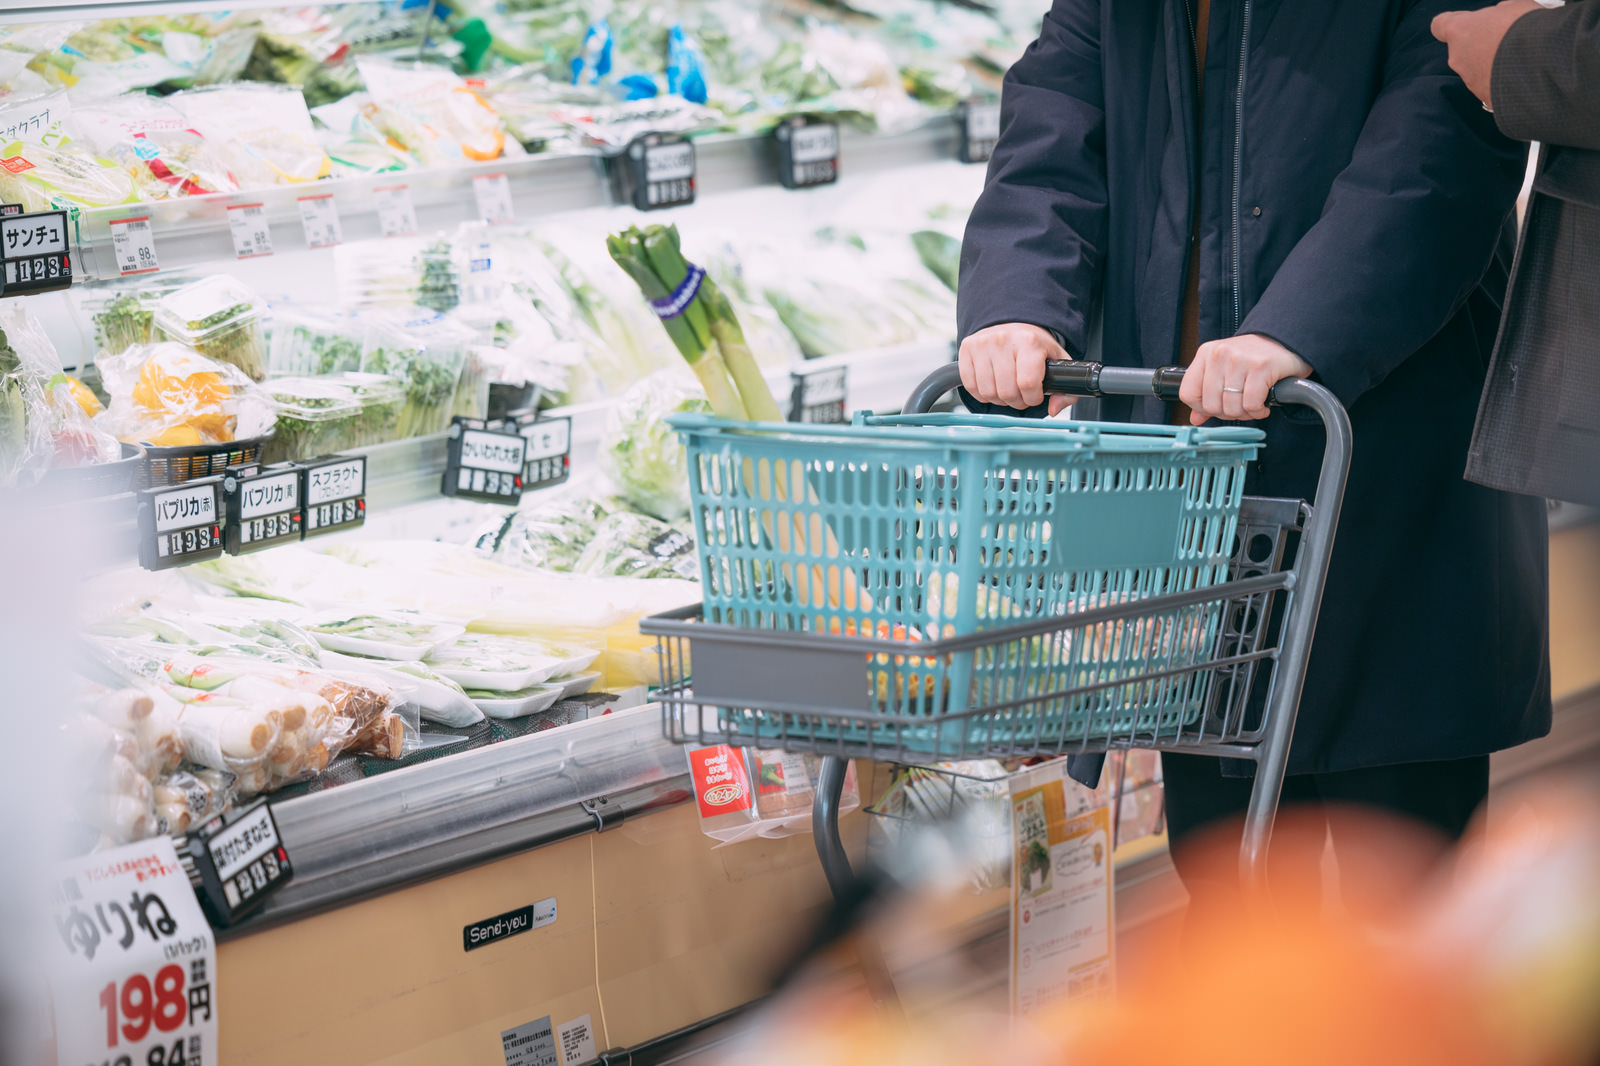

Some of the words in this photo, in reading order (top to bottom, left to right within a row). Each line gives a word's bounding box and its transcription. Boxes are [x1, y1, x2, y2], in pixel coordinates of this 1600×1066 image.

[6, 225, 60, 249] サンチュ
[138, 246, 151, 260] 98
[21, 258, 58, 280] 128
[312, 466, 359, 488] スプラウト
[255, 514, 289, 538] 198
[172, 529, 210, 552] 198
[55, 891, 177, 961] ゆりね
[470, 914, 527, 943] Send-you
[99, 963, 188, 1049] 198
